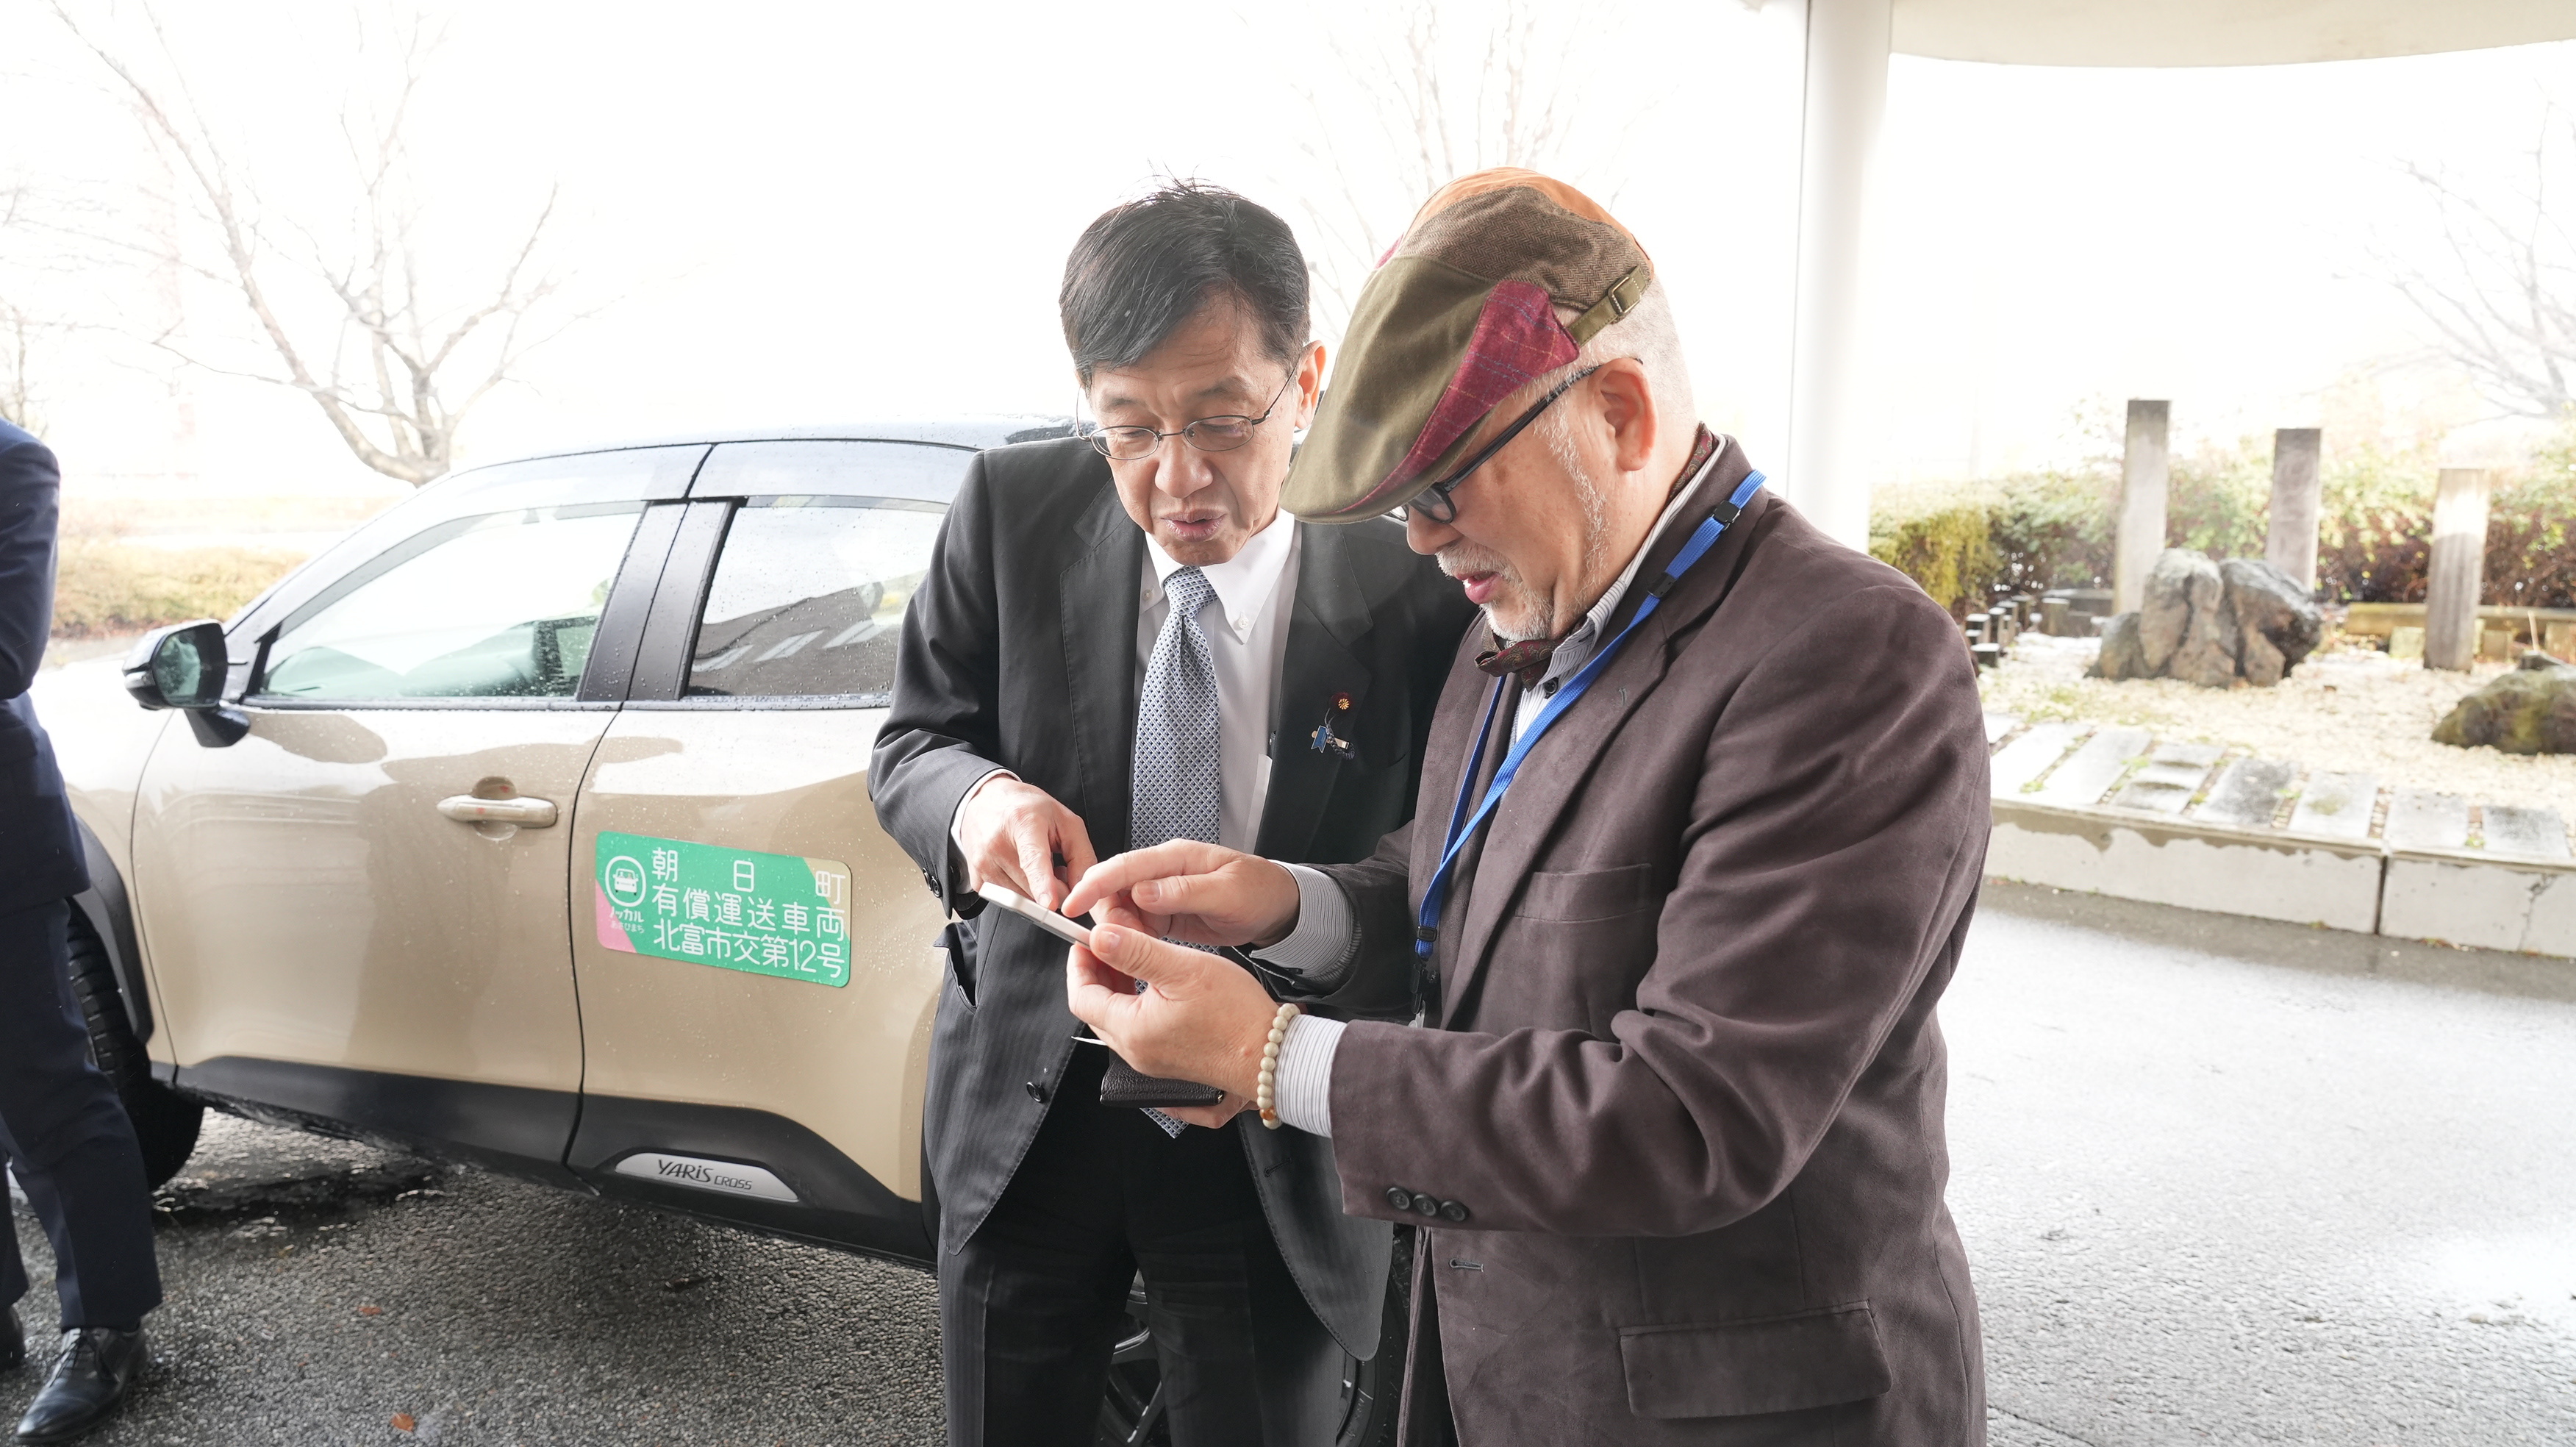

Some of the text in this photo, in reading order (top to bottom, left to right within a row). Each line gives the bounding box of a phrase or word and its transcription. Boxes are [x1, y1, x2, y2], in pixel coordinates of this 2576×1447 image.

[651, 847, 846, 905] 朝日町
[651, 882, 845, 942] 有償運送車両
[653, 918, 845, 978] 北富市交第12号
[714, 1176, 752, 1190] CROSS
